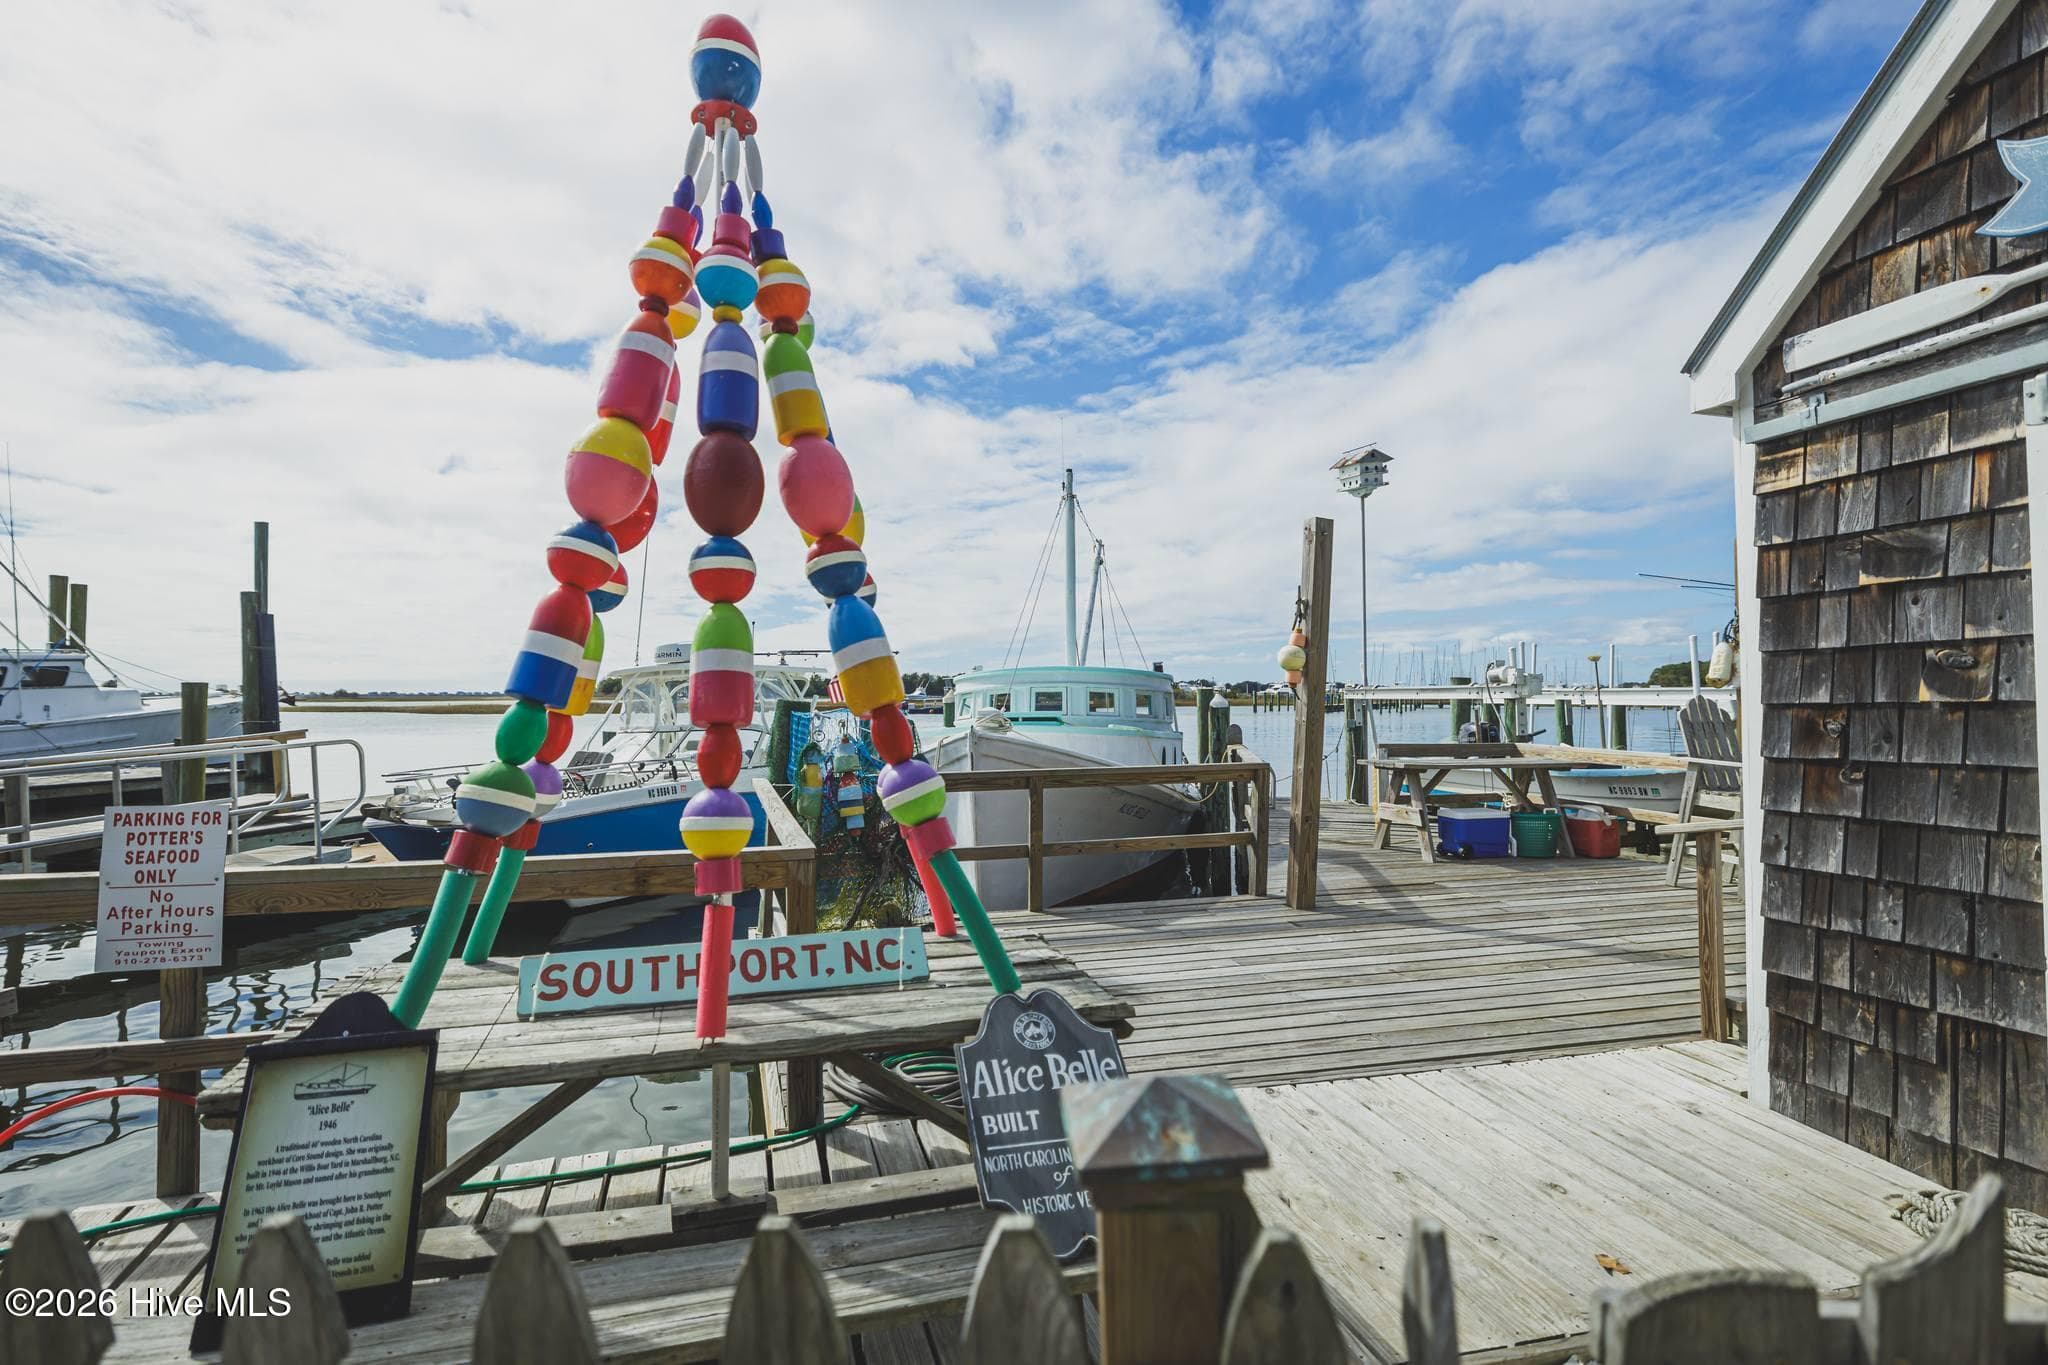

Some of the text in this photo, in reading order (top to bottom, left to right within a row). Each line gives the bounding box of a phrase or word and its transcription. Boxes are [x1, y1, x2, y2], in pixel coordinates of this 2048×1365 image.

[113, 811, 222, 827] PARKING FOR
[126, 830, 204, 846] POTTER'S
[124, 849, 200, 865] SEAFOOD
[134, 869, 177, 884] ONLY
[150, 889, 174, 903] No
[106, 905, 215, 920] After Hours
[121, 920, 199, 936] Parking.
[115, 946, 212, 957] Yaupon Exxon
[137, 941, 184, 949] Towing
[114, 954, 203, 966] 910-278-6373
[537, 937, 914, 1002] SOUTHORT, N.C.
[972, 1049, 1118, 1099] Alice Belle
[318, 1119, 337, 1131] 1946
[981, 1109, 1040, 1136] BUILT
[983, 1146, 1073, 1174] NORTH CAROLIN
[1053, 1166, 1075, 1190] of
[1022, 1195, 1075, 1216] HISTORIC
